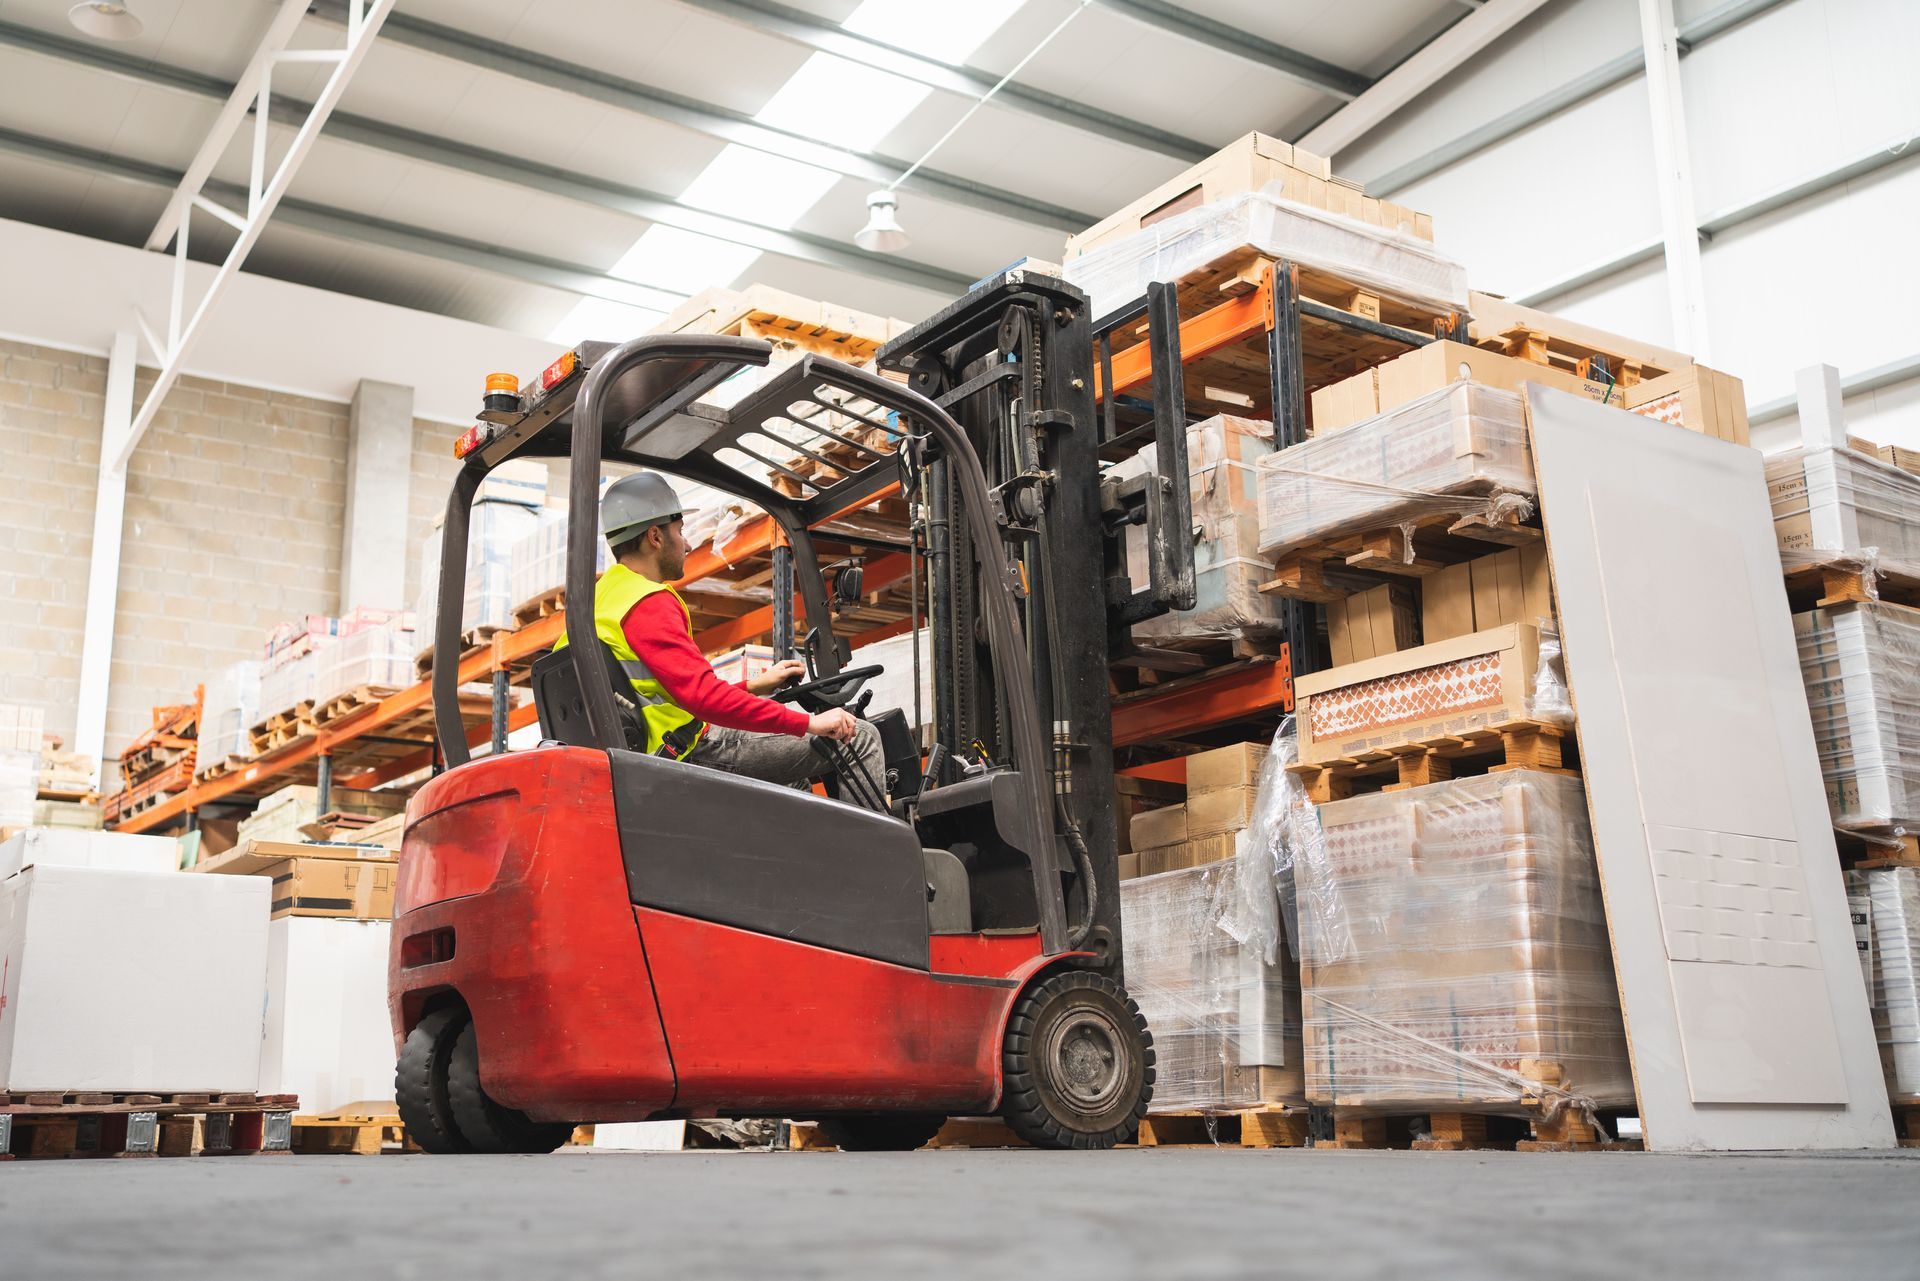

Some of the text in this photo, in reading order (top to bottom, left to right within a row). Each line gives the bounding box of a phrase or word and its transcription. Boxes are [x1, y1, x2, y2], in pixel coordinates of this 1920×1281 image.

[1583, 384, 1600, 395] 25cm
[1778, 482, 1797, 492] 15cm
[1783, 534, 1802, 543] 15cm
